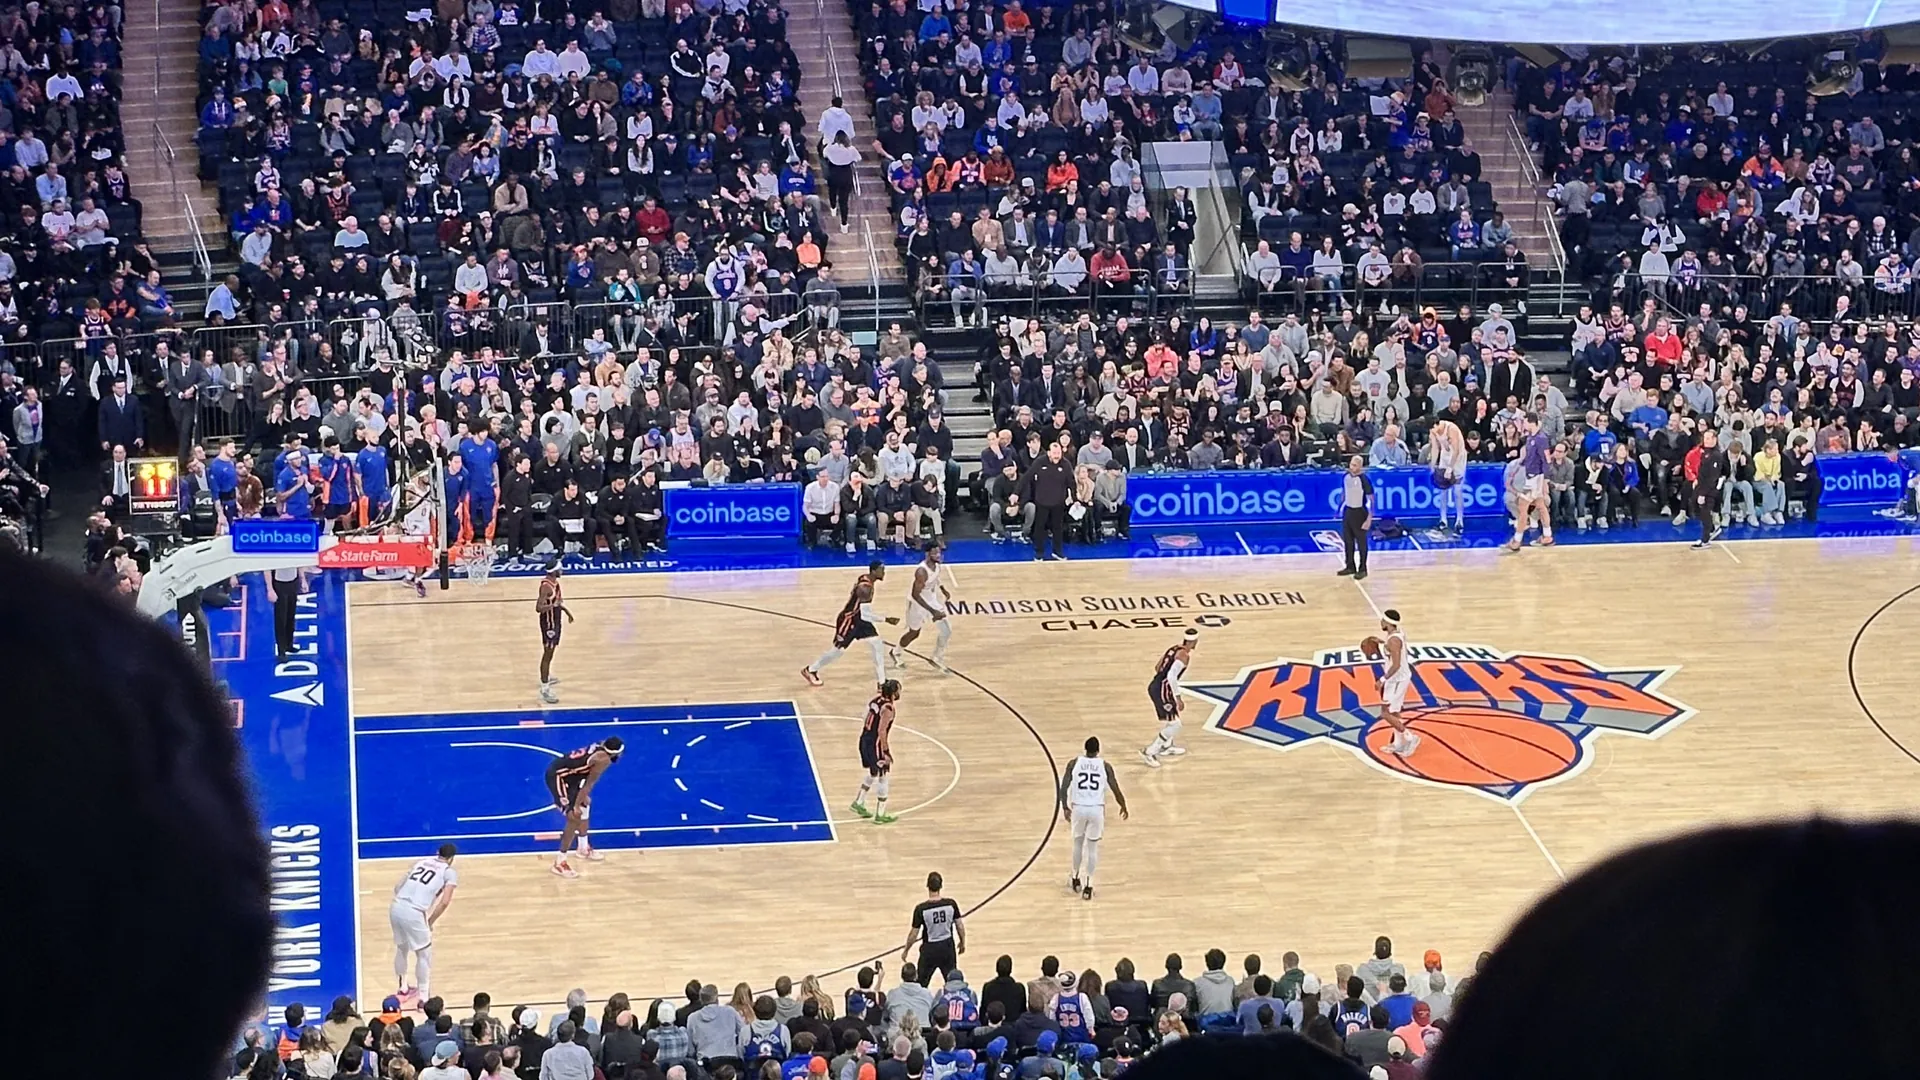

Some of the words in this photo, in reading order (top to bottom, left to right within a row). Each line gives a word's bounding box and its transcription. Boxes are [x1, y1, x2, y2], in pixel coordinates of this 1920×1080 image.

[1134, 482, 1306, 517] coinbase
[676, 501, 790, 524] coinbase
[239, 529, 312, 544] coinbase
[1041, 616, 1188, 631] CHASE
[1078, 773, 1101, 791] 25
[270, 824, 321, 912] KNICKS
[409, 867, 436, 885] 20
[933, 910, 946, 924] 29
[268, 922, 321, 992] YORK
[1060, 1013, 1080, 1028] 33
